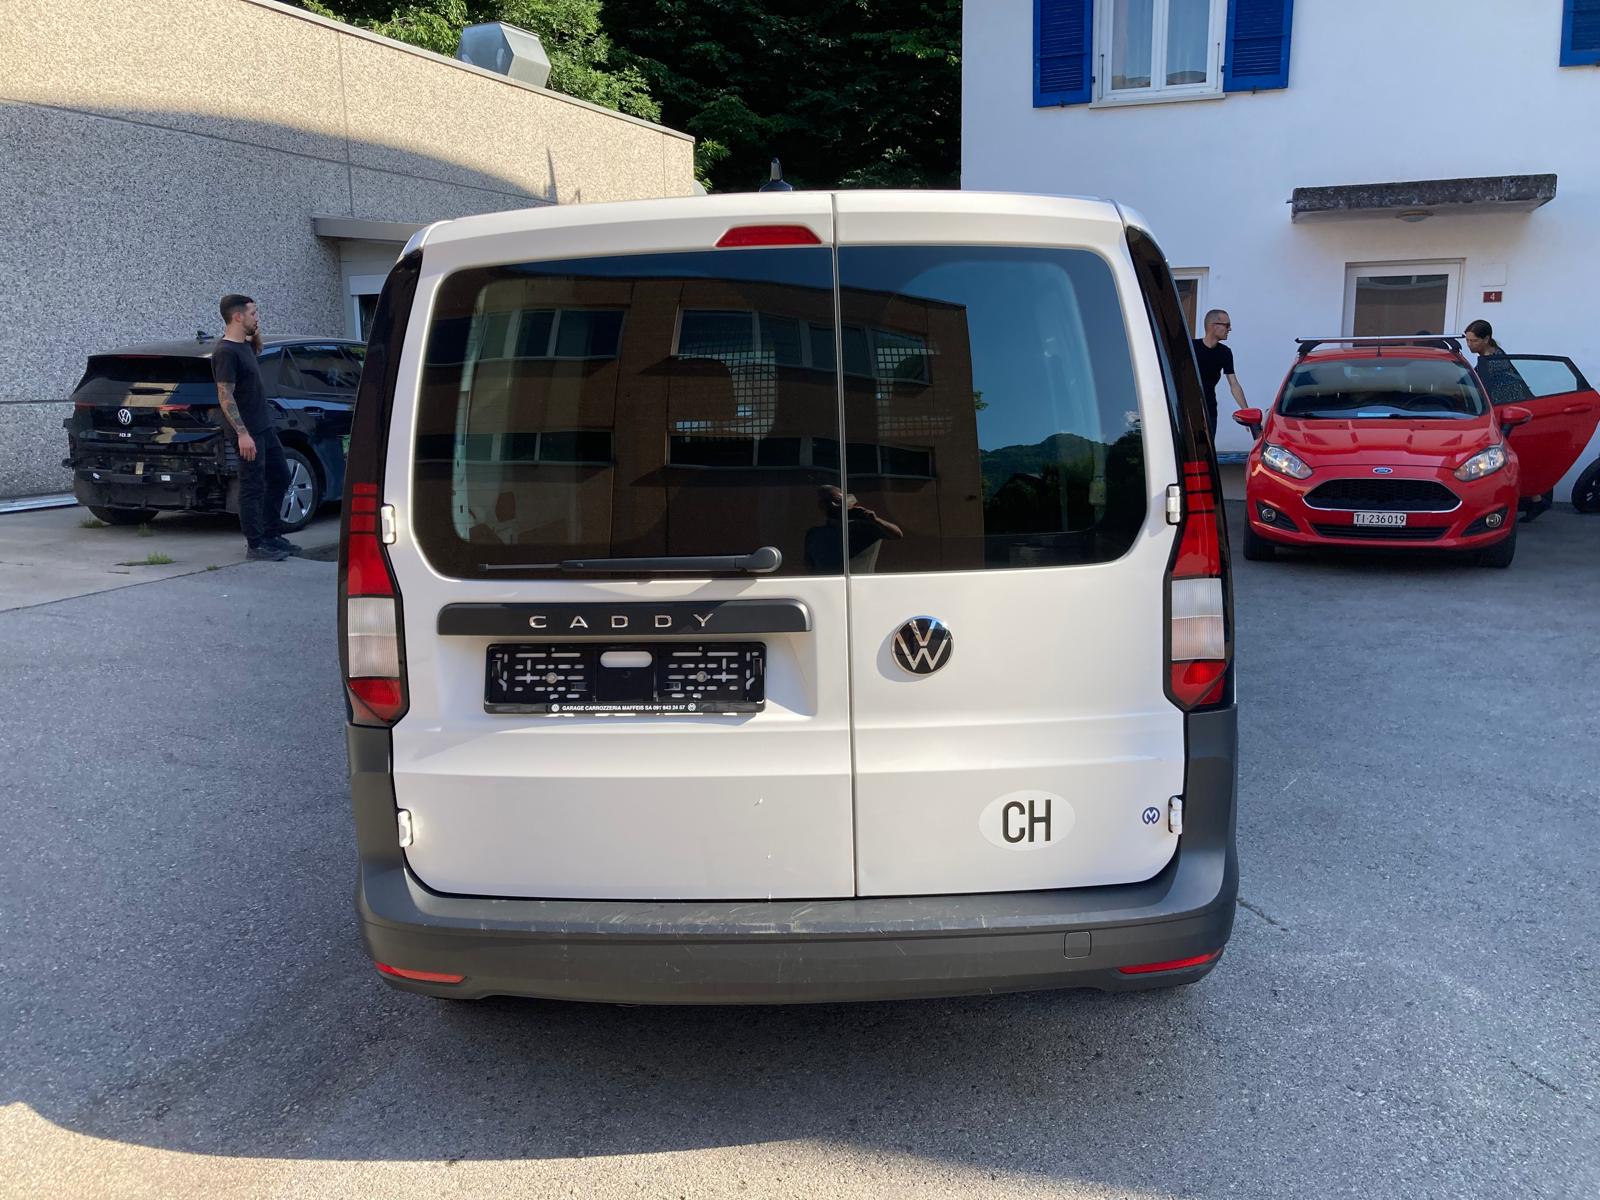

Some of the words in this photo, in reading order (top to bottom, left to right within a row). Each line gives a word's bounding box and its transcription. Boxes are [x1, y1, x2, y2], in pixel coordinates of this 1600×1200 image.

[1356, 514, 1365, 523] TI
[1369, 514, 1405, 524] 236019
[529, 613, 714, 629] CADDY
[1002, 799, 1051, 843] CH
